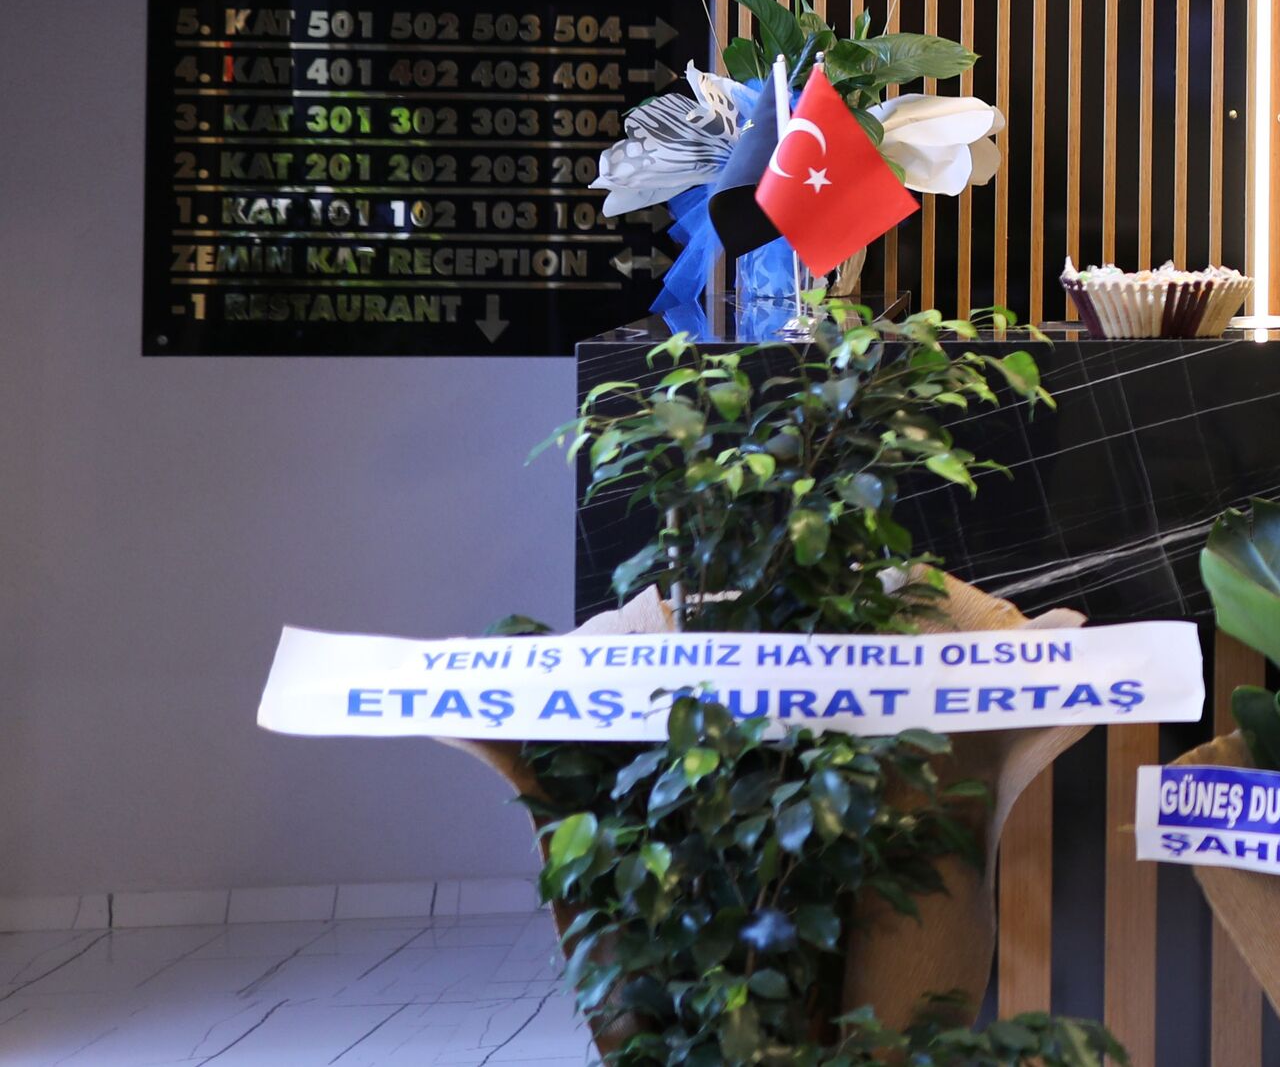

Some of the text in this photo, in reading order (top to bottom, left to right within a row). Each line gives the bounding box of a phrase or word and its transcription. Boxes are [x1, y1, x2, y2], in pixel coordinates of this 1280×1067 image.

[225, 8, 295, 33] KAT
[307, 10, 372, 37] 501
[389, 12, 459, 40] 502
[472, 13, 541, 41] 503
[554, 15, 622, 43] 504
[223, 55, 295, 83] KAT
[306, 57, 372, 85] 401
[389, 59, 459, 86] 402
[471, 60, 540, 88] 403
[553, 61, 621, 90] 404
[222, 104, 294, 131] KAT
[306, 105, 371, 132] 301
[389, 106, 458, 134] 302
[471, 107, 540, 135] 303
[552, 109, 620, 137] 304
[220, 152, 292, 179] KAT
[305, 152, 371, 181] 201
[388, 153, 457, 182] 202
[470, 154, 539, 183] 203
[552, 156, 597, 183] 20
[222, 197, 290, 225] KAT
[308, 199, 370, 226] 101
[390, 200, 456, 228] 102
[472, 201, 538, 229] 103
[306, 245, 376, 275] KAT
[389, 248, 588, 278] RECEPTION
[224, 294, 462, 323] RESTAURANT
[423, 638, 1073, 673] YENİ İŞ YERİNİZ HAYIRLI OLSUN
[347, 688, 516, 727] ETAŞ
[537, 689, 643, 727] AŞ.
[934, 680, 1146, 714] ERTAŞ
[1160, 774, 1243, 828] GÜNEŞ
